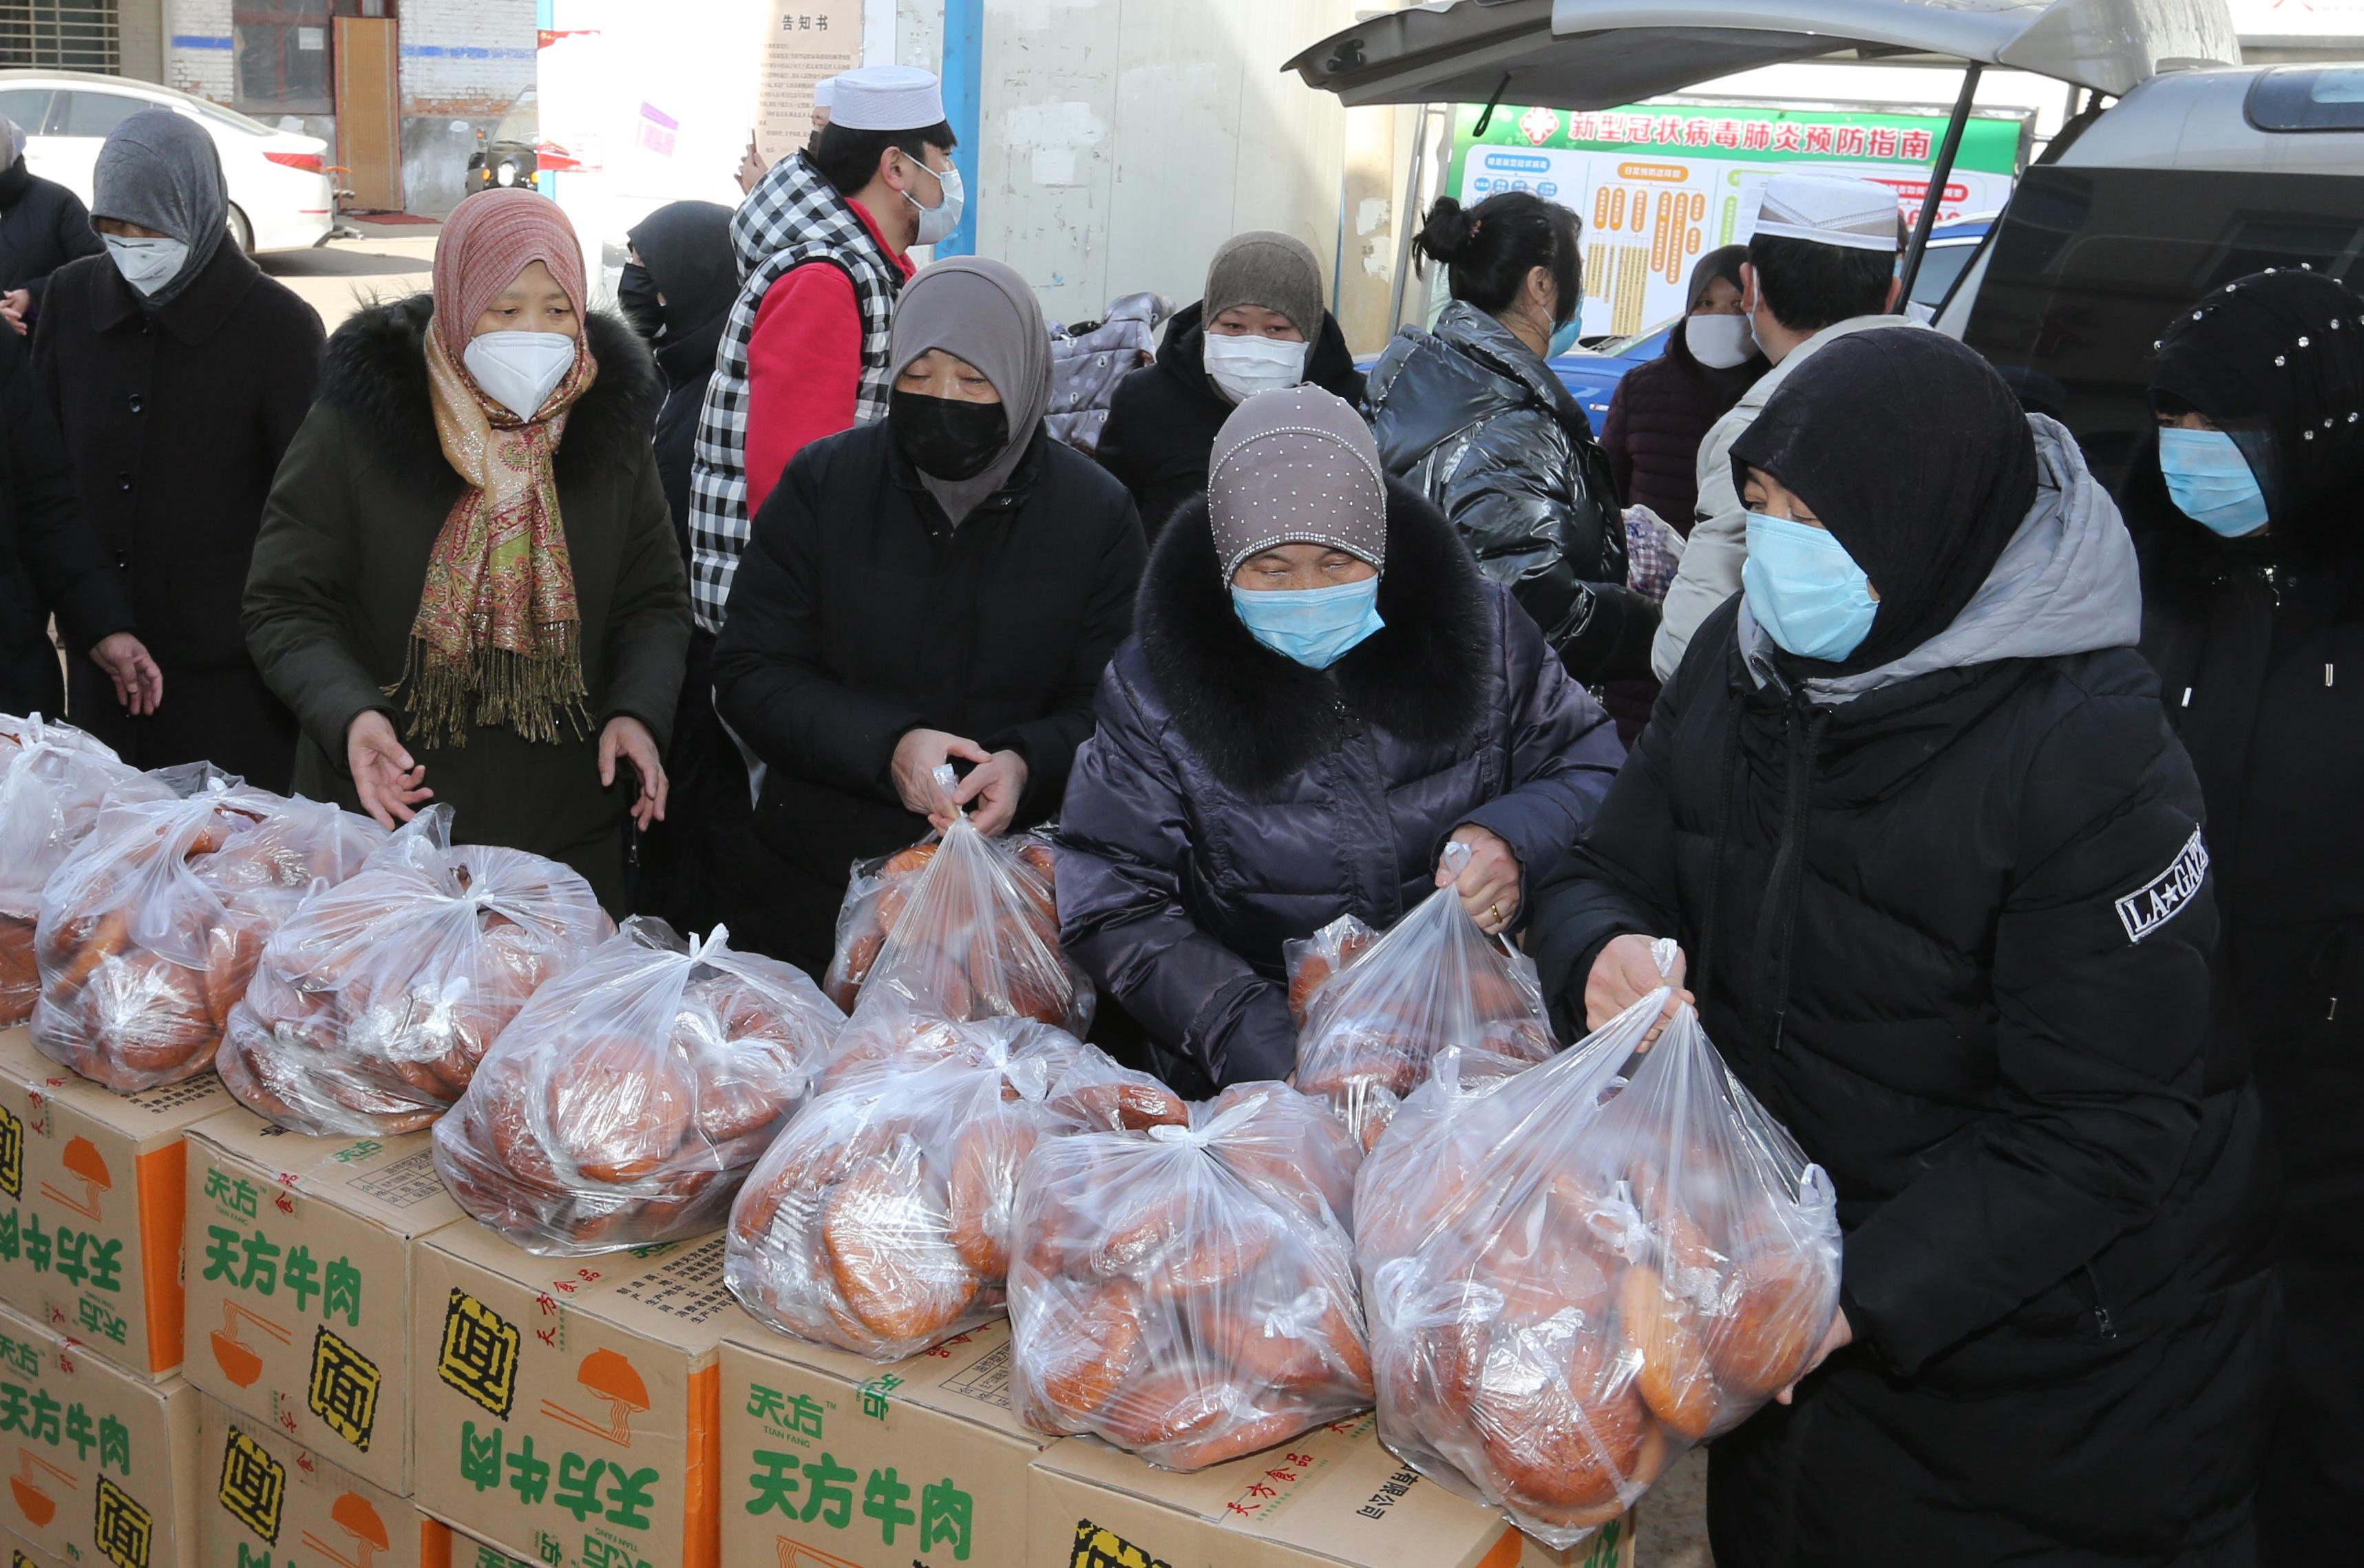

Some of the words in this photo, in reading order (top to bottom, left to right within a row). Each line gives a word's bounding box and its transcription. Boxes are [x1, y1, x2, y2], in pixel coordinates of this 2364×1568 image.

[781, 14, 829, 32] 告知书
[1568, 110, 1932, 160] 新型冠状病毒肺炎预防指南
[2123, 888, 2170, 932] LA
[204, 1167, 259, 1218] 天方
[0, 1207, 123, 1293] 天方牛肉
[202, 1225, 361, 1326] 天方牛肉
[0, 1381, 131, 1476] 天方牛肉
[746, 1383, 824, 1441] 天方
[763, 1425, 785, 1439] TIAN
[786, 1433, 811, 1449] FANG
[460, 1421, 660, 1531] 天方牛肉
[745, 1450, 973, 1562] 天方牛肉
